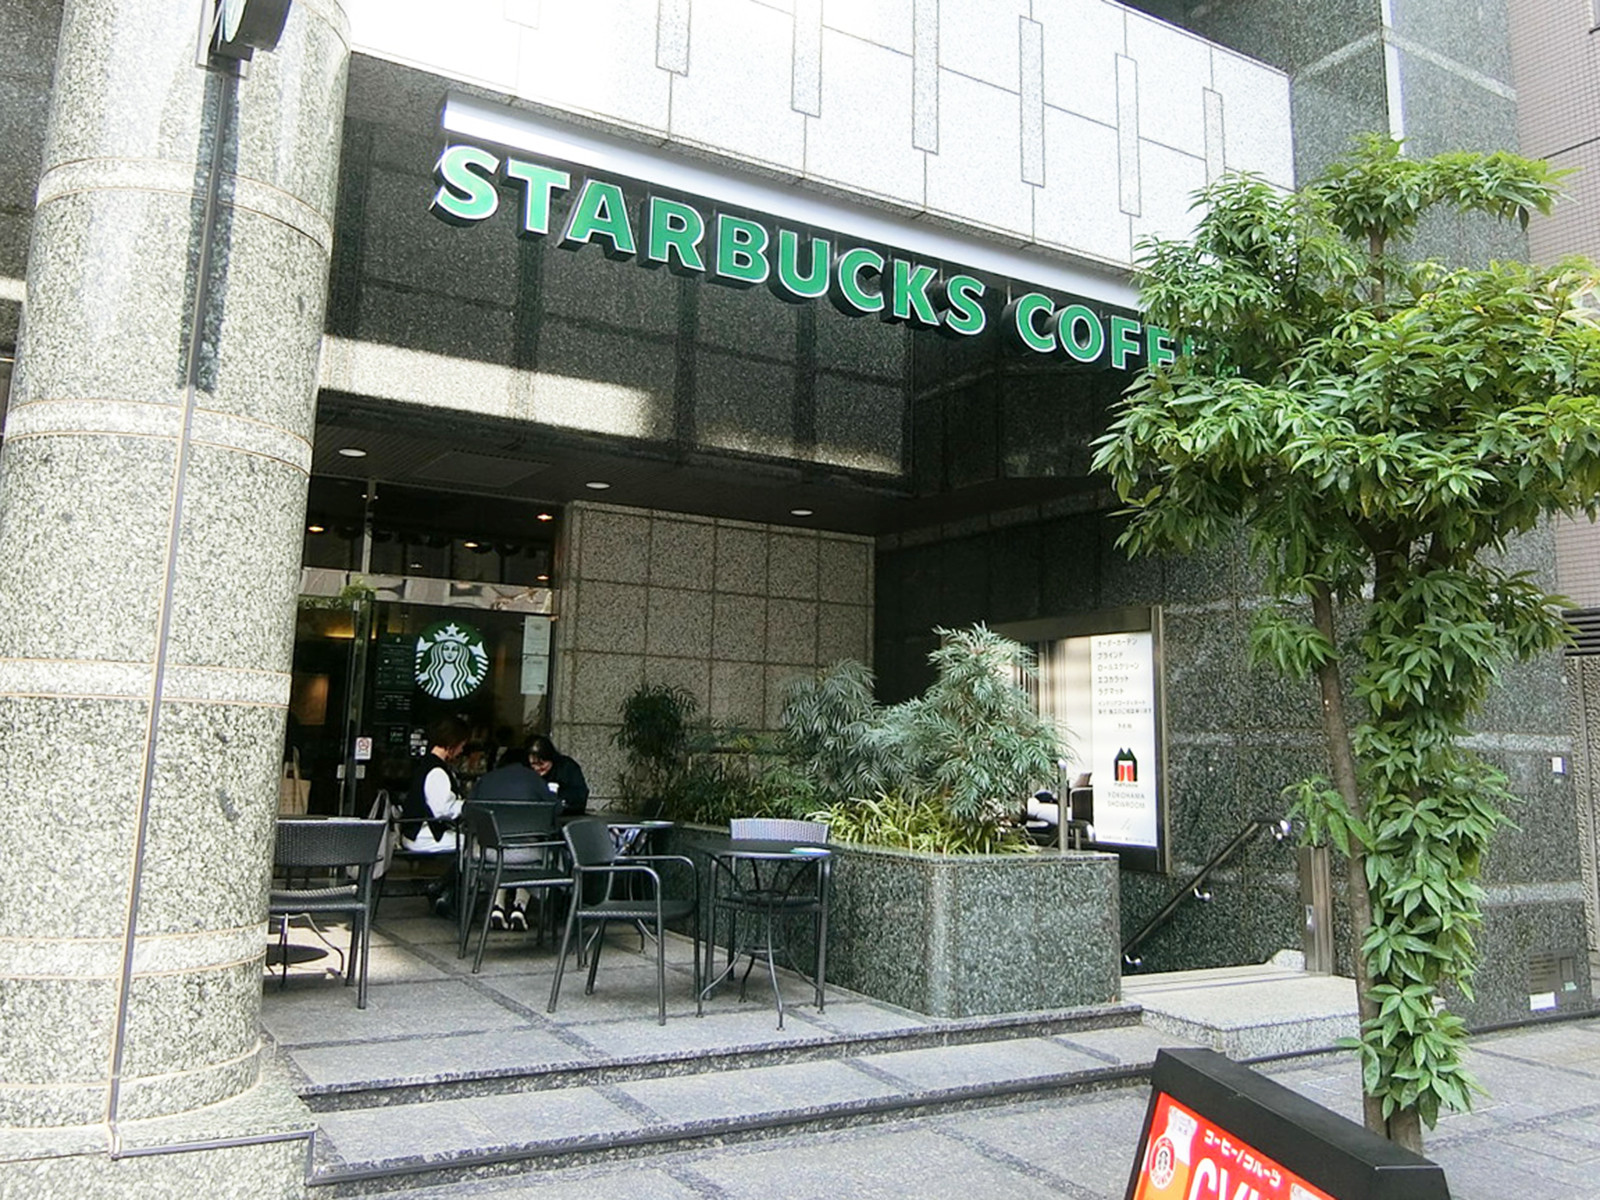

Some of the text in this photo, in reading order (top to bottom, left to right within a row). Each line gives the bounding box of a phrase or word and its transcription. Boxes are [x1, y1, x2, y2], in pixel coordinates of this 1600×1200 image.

[432, 144, 1232, 376] STARBUCKS COFF
[1107, 791, 1145, 799] YOKOHAMA
